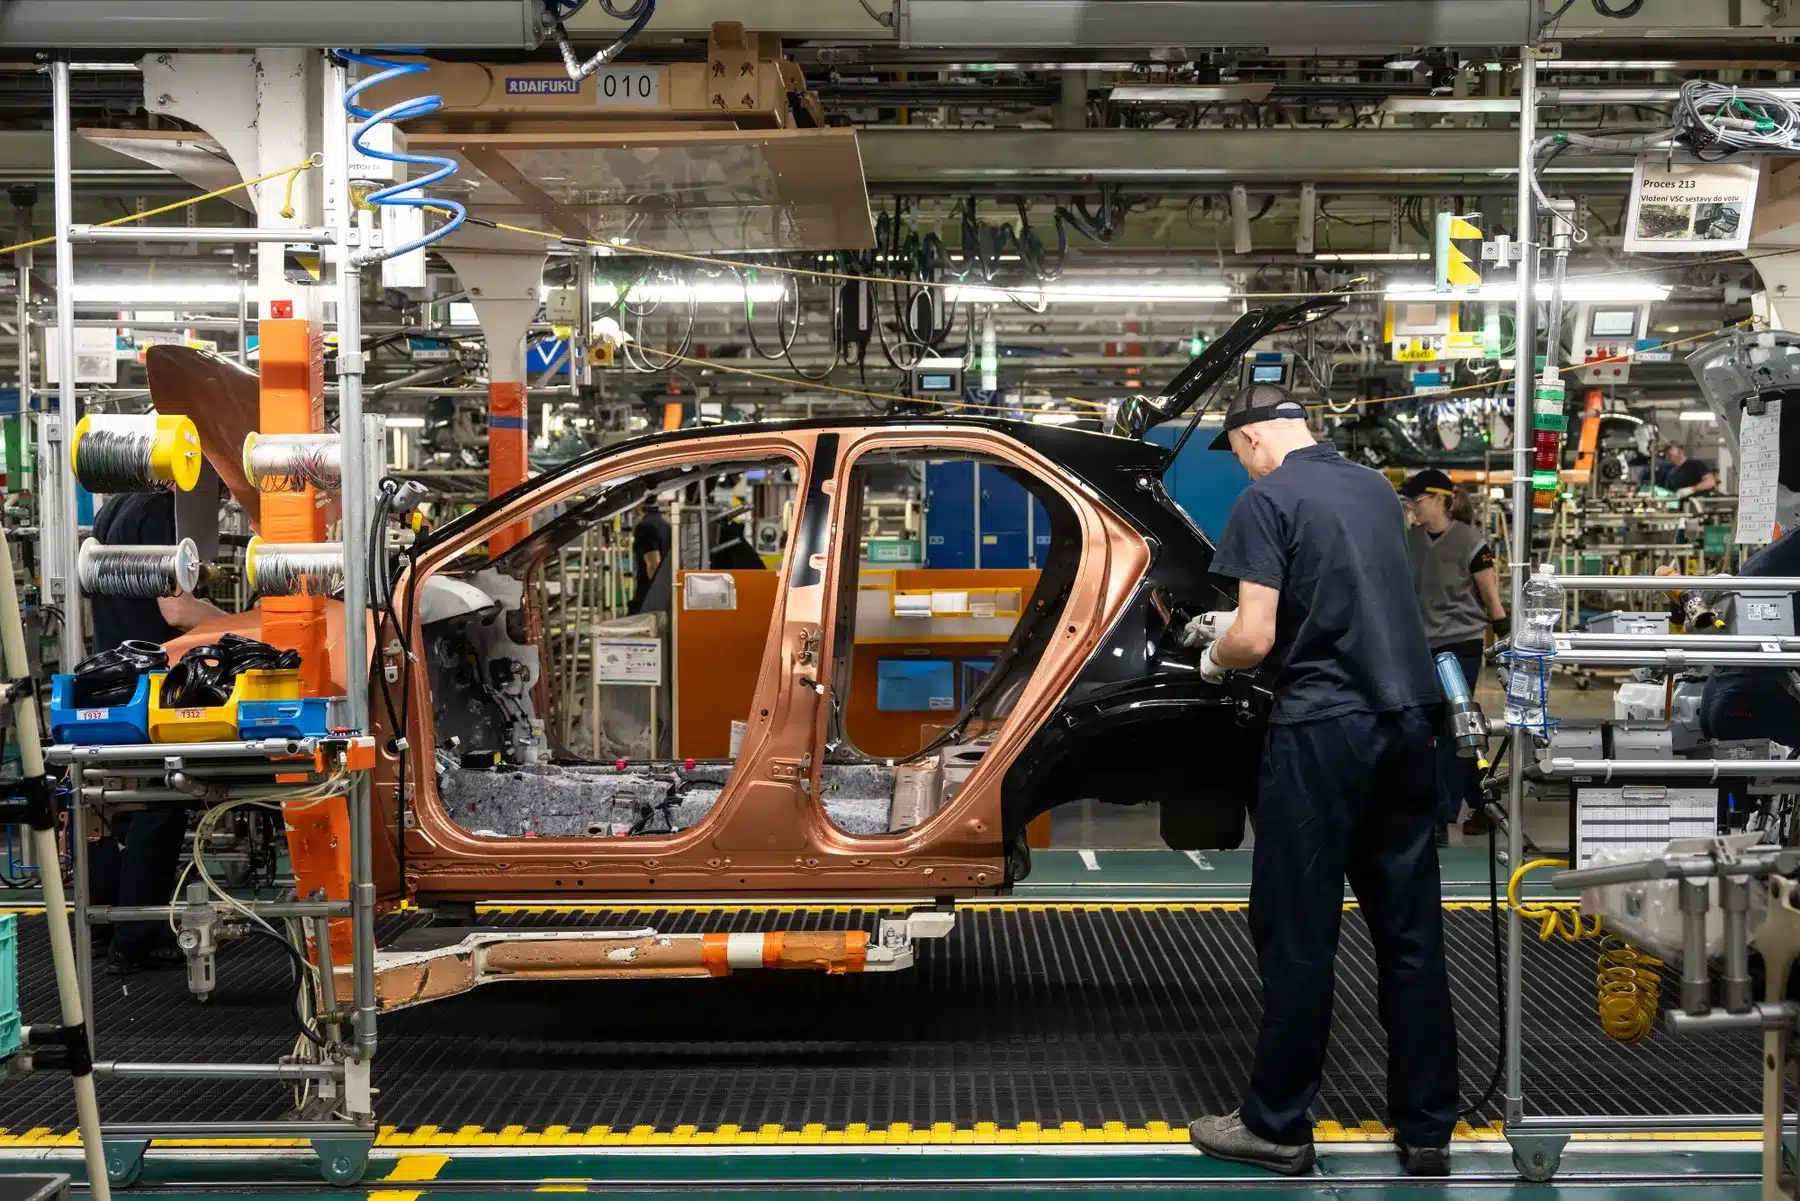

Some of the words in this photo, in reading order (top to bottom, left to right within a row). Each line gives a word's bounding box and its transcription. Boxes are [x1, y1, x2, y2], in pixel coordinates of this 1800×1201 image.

[518, 80, 576, 92] DAIFUKU
[603, 75, 651, 97] 010
[1643, 180, 1675, 188] Proces
[1678, 180, 1696, 189] 213
[560, 296, 566, 306] 7
[181, 711, 200, 719] T312
